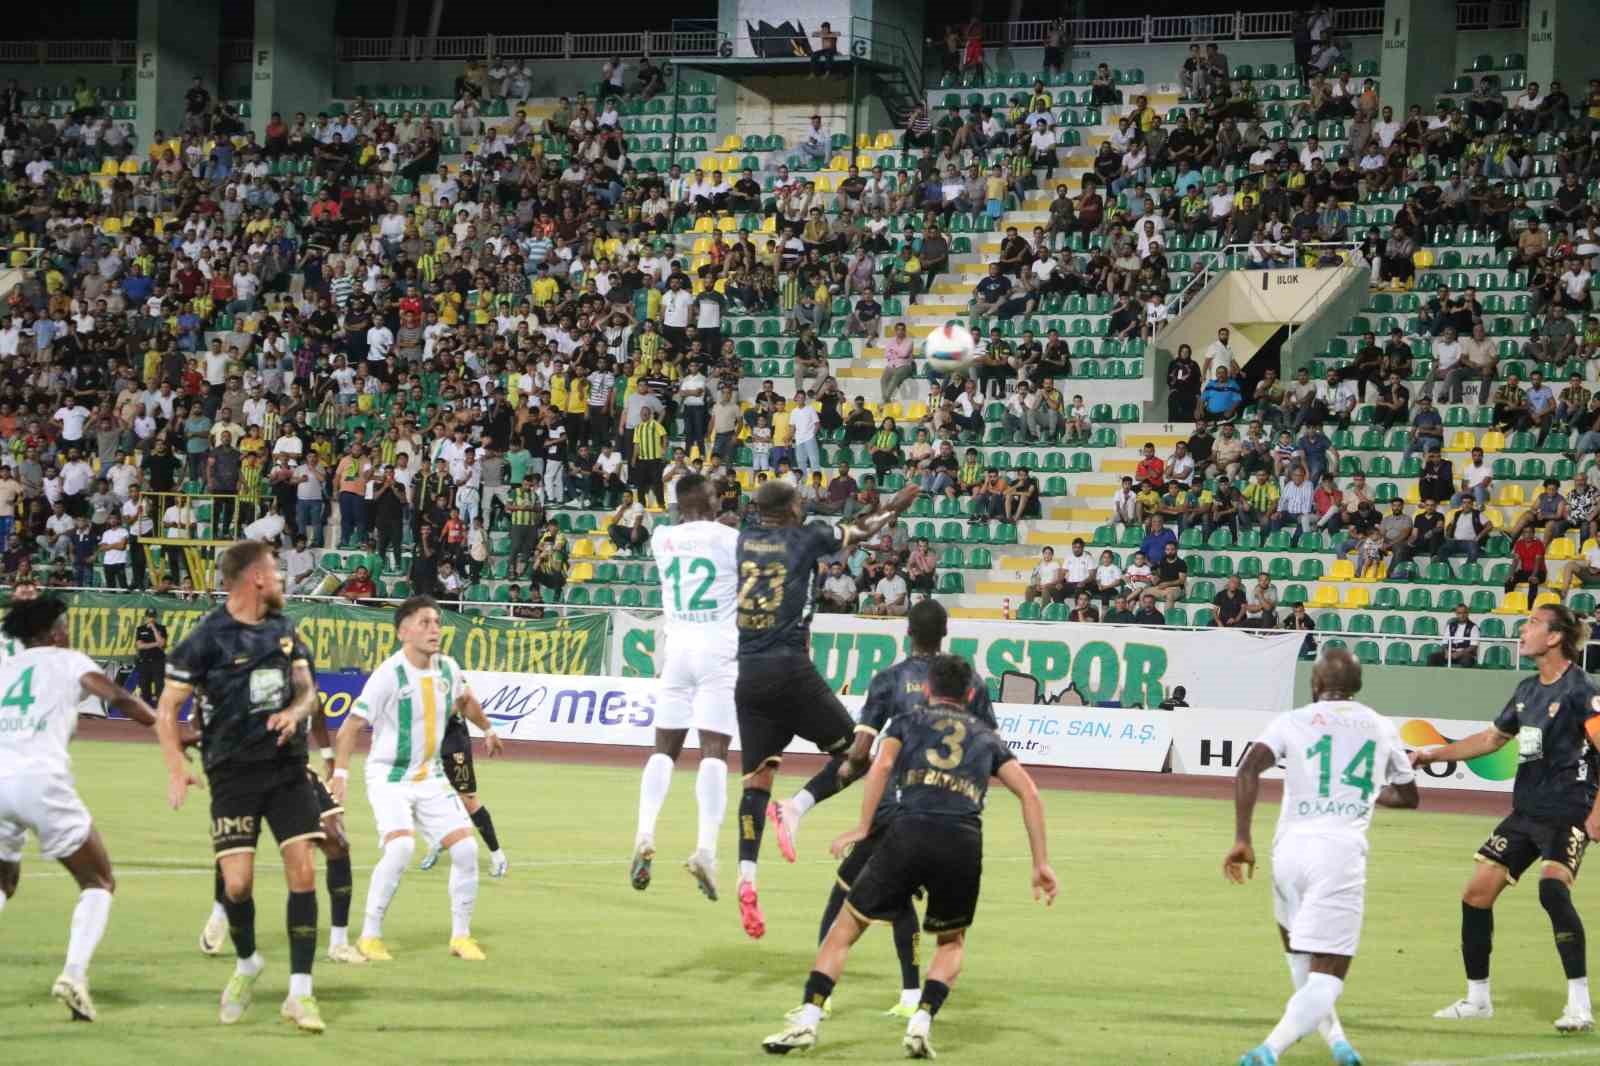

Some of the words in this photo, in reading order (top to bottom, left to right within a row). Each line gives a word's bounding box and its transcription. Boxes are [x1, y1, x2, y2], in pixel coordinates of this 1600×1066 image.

[1277, 274, 1298, 285] BLOK
[664, 556, 718, 611] 12
[740, 560, 787, 611] 23
[464, 617, 589, 676] ÖLÜRÜZ
[0, 665, 36, 715] 4
[550, 689, 657, 728] mes
[925, 718, 967, 770] 3
[1028, 716, 1060, 736] TİC.
[1067, 718, 1113, 739] SAN.
[1119, 722, 1157, 744] A.Ş.
[1306, 734, 1377, 801] 14
